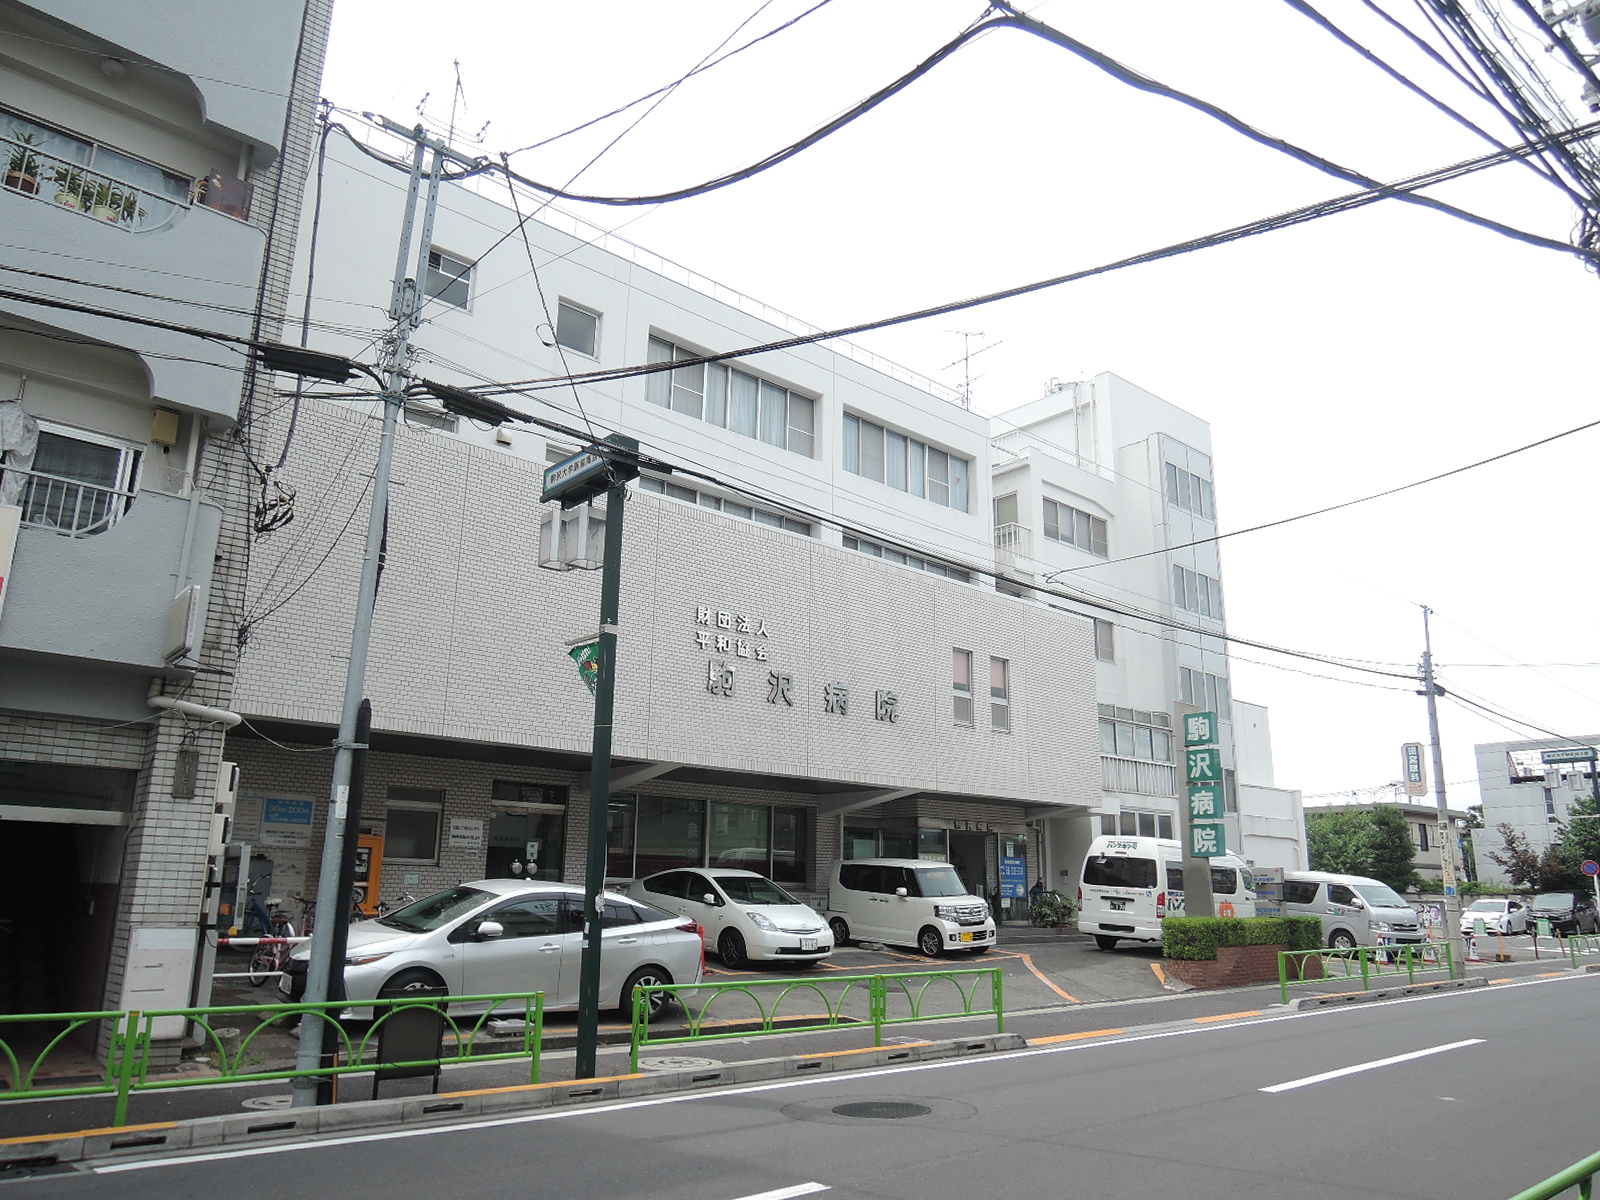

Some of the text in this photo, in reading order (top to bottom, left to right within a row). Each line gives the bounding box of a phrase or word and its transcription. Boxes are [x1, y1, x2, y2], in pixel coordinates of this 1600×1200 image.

[696, 605, 769, 638] 財団法人
[696, 631, 769, 661] 平和協会
[707, 660, 900, 723] 駒沢病院
[1187, 716, 1217, 853] 駒沢病院
